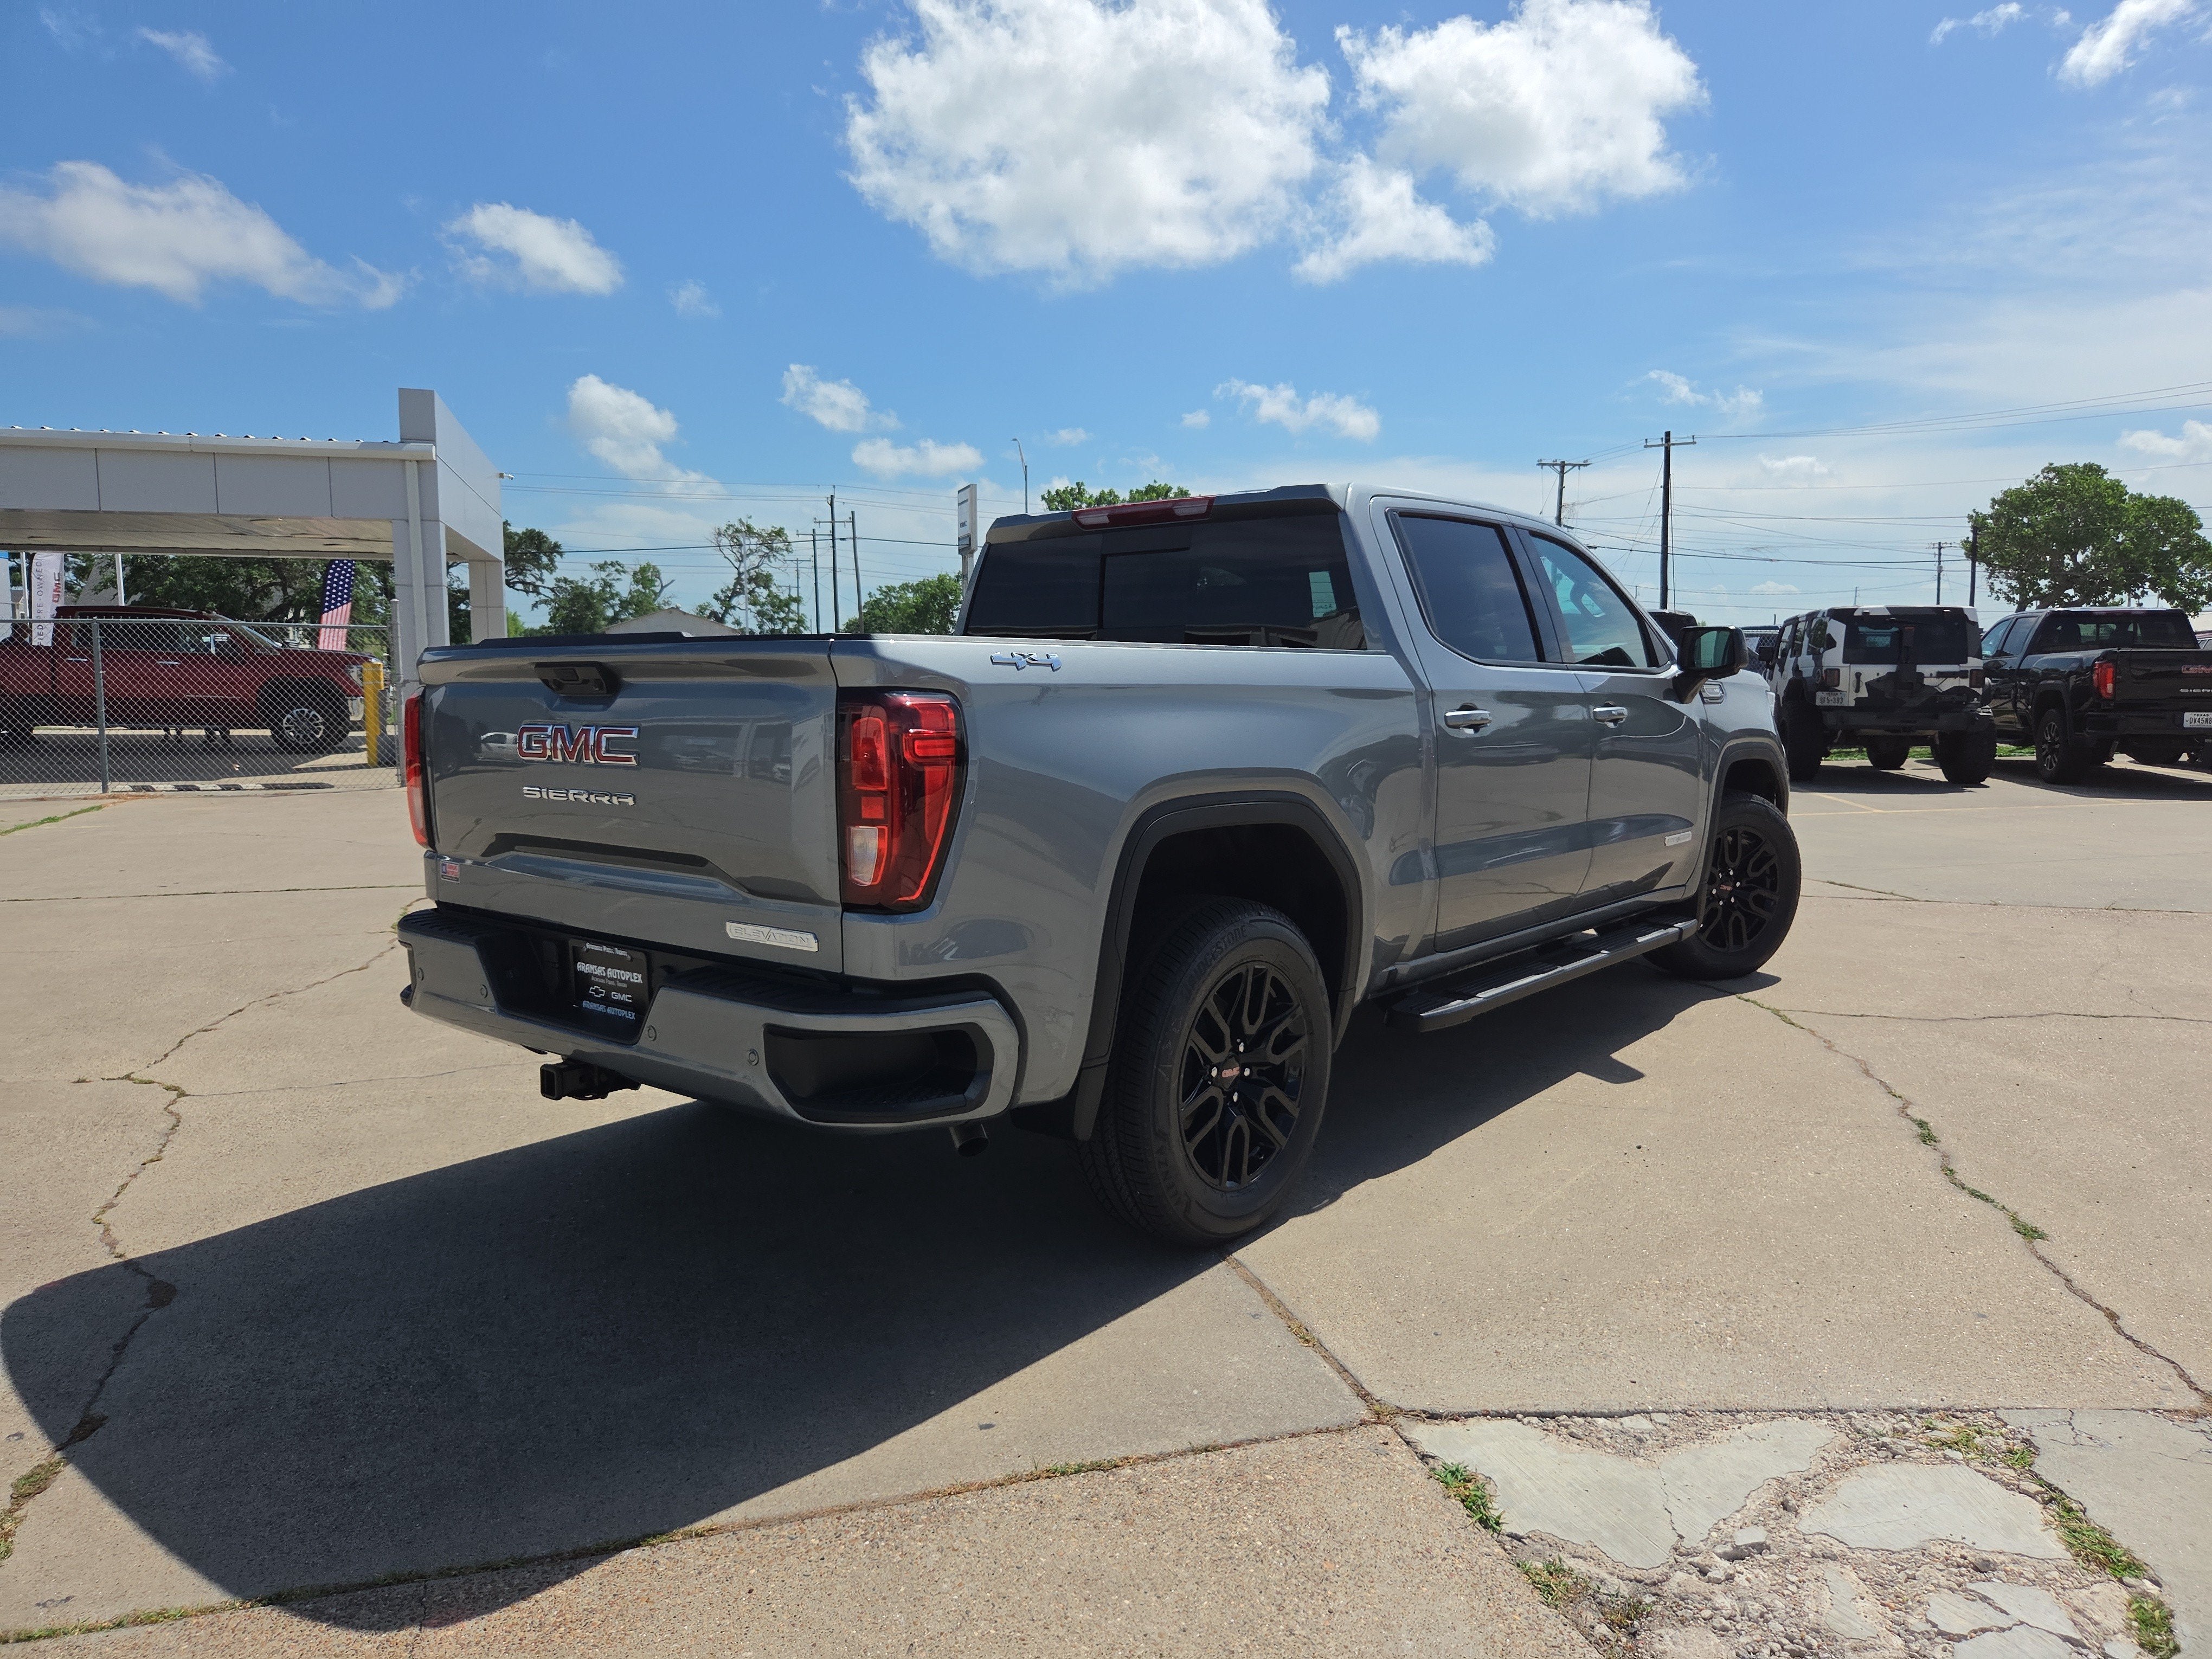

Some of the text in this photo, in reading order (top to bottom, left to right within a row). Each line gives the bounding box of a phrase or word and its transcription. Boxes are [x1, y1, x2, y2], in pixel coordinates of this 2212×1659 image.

[52, 572, 61, 603] GMC
[517, 724, 639, 766] GMC
[523, 786, 636, 806] SIERRA
[733, 926, 809, 946] ELEVATION
[577, 961, 643, 983] ARANSAS AUTOPLEX
[611, 992, 632, 1002] GMC
[607, 1007, 635, 1020] AUTOPLEX
